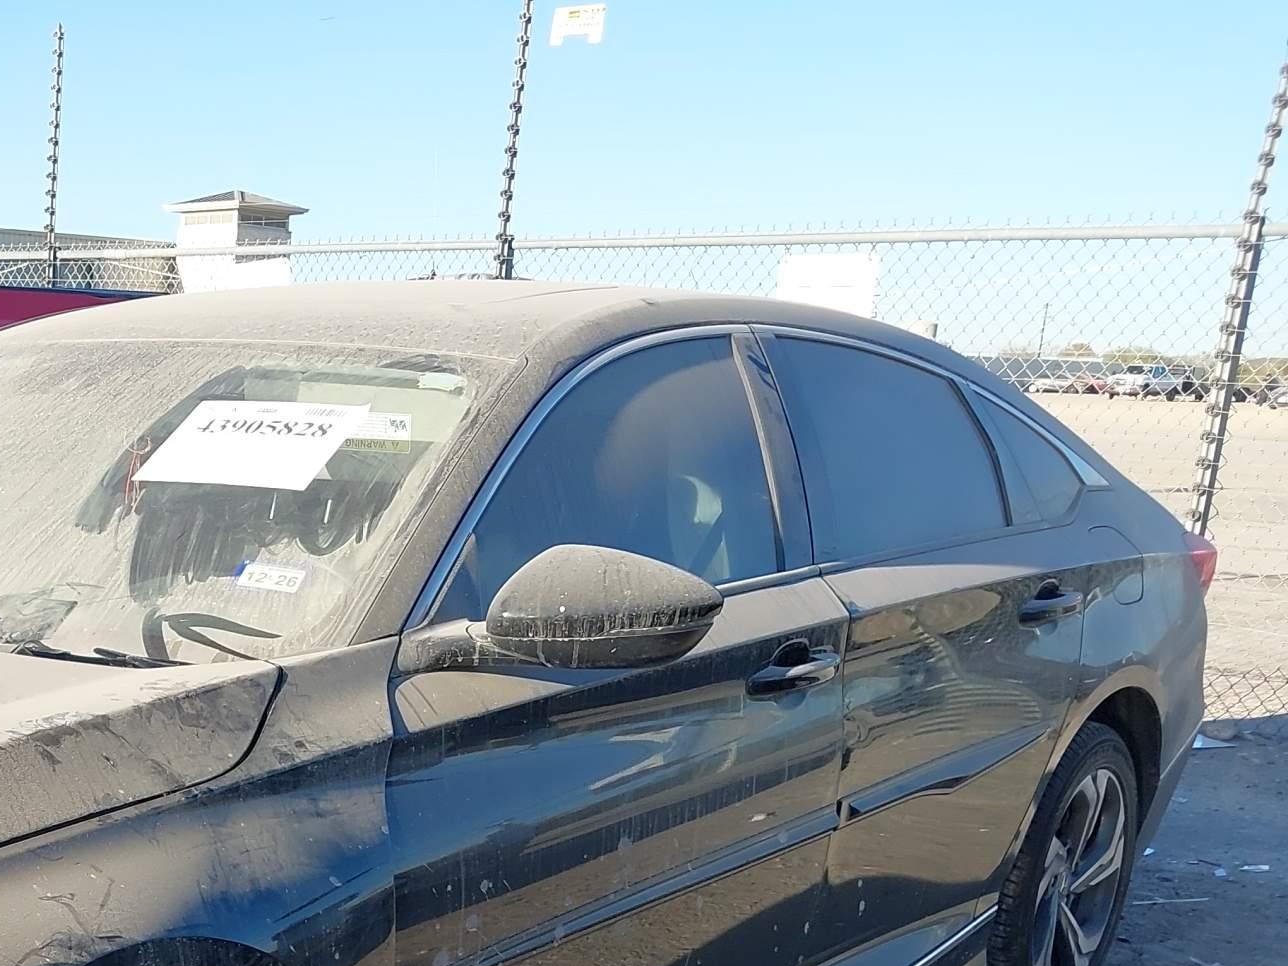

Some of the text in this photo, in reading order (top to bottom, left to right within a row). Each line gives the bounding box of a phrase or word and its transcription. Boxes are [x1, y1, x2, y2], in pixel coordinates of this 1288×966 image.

[196, 417, 334, 438] 43905828
[344, 438, 388, 449] WARNING
[274, 573, 299, 588] 26
